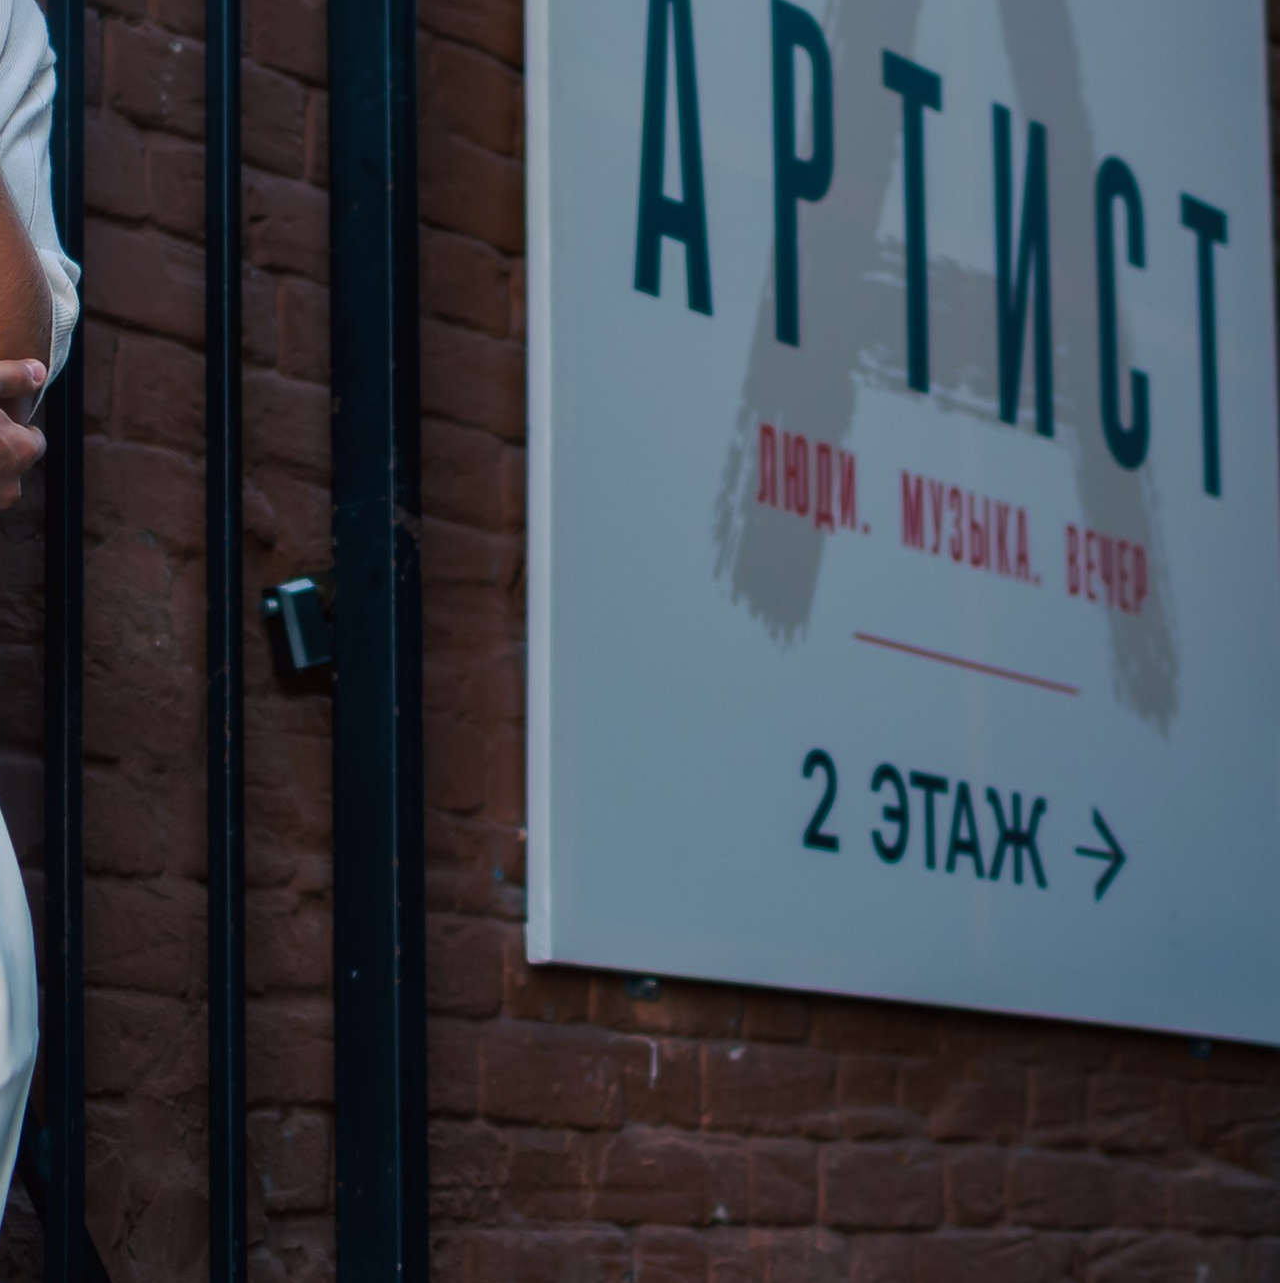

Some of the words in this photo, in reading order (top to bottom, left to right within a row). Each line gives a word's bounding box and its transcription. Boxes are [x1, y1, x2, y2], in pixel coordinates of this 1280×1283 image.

[757, 422, 871, 536] ЛЮДИ.
[900, 468, 1041, 586] МУЗЫКА.
[1065, 522, 1147, 615] ВЕЧЕР
[802, 748, 840, 853] 2
[870, 763, 1048, 889] ЭТАЖ
